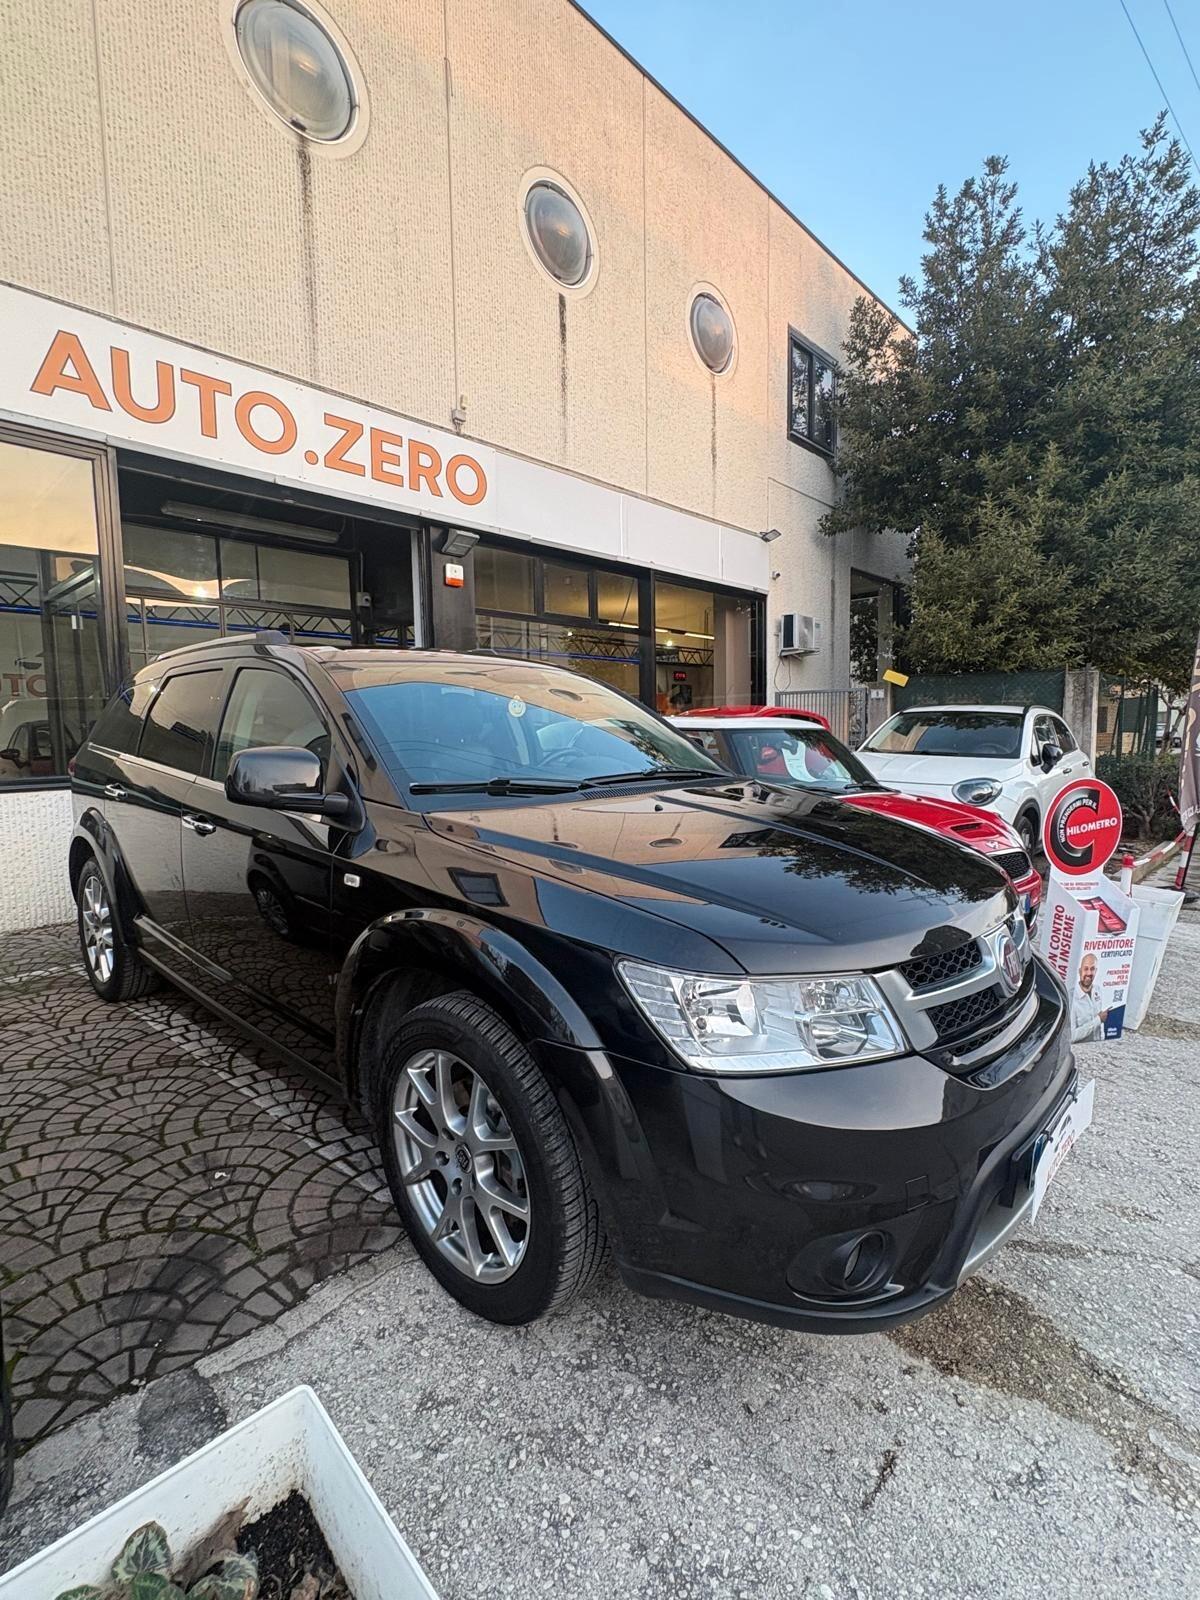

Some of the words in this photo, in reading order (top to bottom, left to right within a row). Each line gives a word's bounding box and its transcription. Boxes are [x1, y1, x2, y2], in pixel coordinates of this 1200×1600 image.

[30, 329, 488, 506] AUTO.ZERO
[1049, 905, 1065, 950] CONTRO
[1059, 914, 1076, 963] INSIEME
[1083, 939, 1134, 951] RIVENDITORE
[1100, 950, 1133, 958] CERTIFICATO
